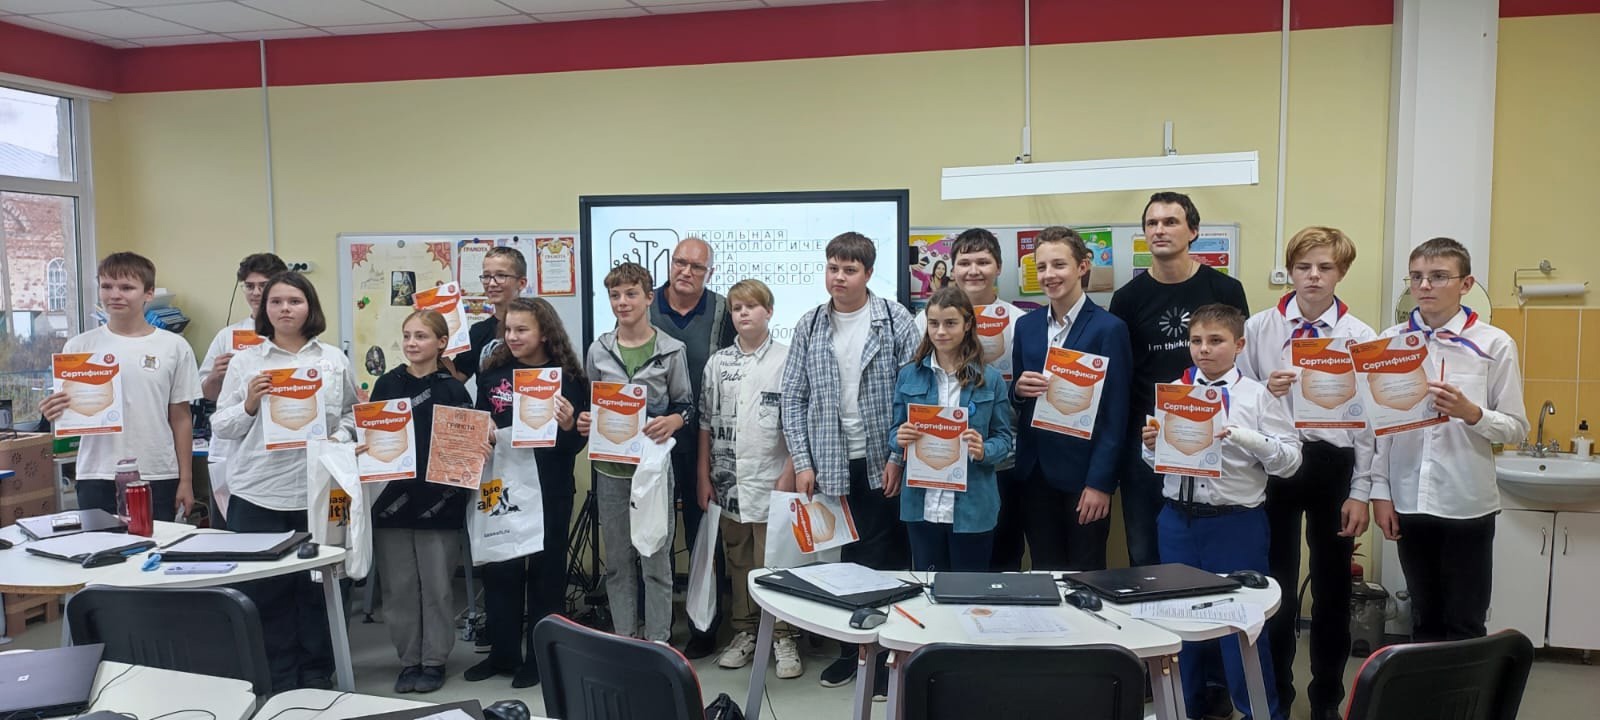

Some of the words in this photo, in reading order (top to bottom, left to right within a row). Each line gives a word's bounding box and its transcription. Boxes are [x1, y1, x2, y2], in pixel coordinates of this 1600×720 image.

[687, 231, 785, 240] ШКОЛЬНАЯ
[715, 263, 824, 273] ЛДОМСКОГО
[1165, 340, 1191, 351] thinki
[1300, 355, 1351, 366] Сертифика
[1362, 353, 1421, 370] Сертификат
[61, 369, 114, 378] Сертификат
[1051, 364, 1098, 380] Сертификат
[519, 385, 556, 393] Сертификат
[598, 398, 640, 408] Сертификат
[1163, 402, 1214, 413] Сертификат
[362, 416, 407, 427] Сертификат
[915, 421, 961, 432] Сертификат
[477, 497, 492, 510] alt
